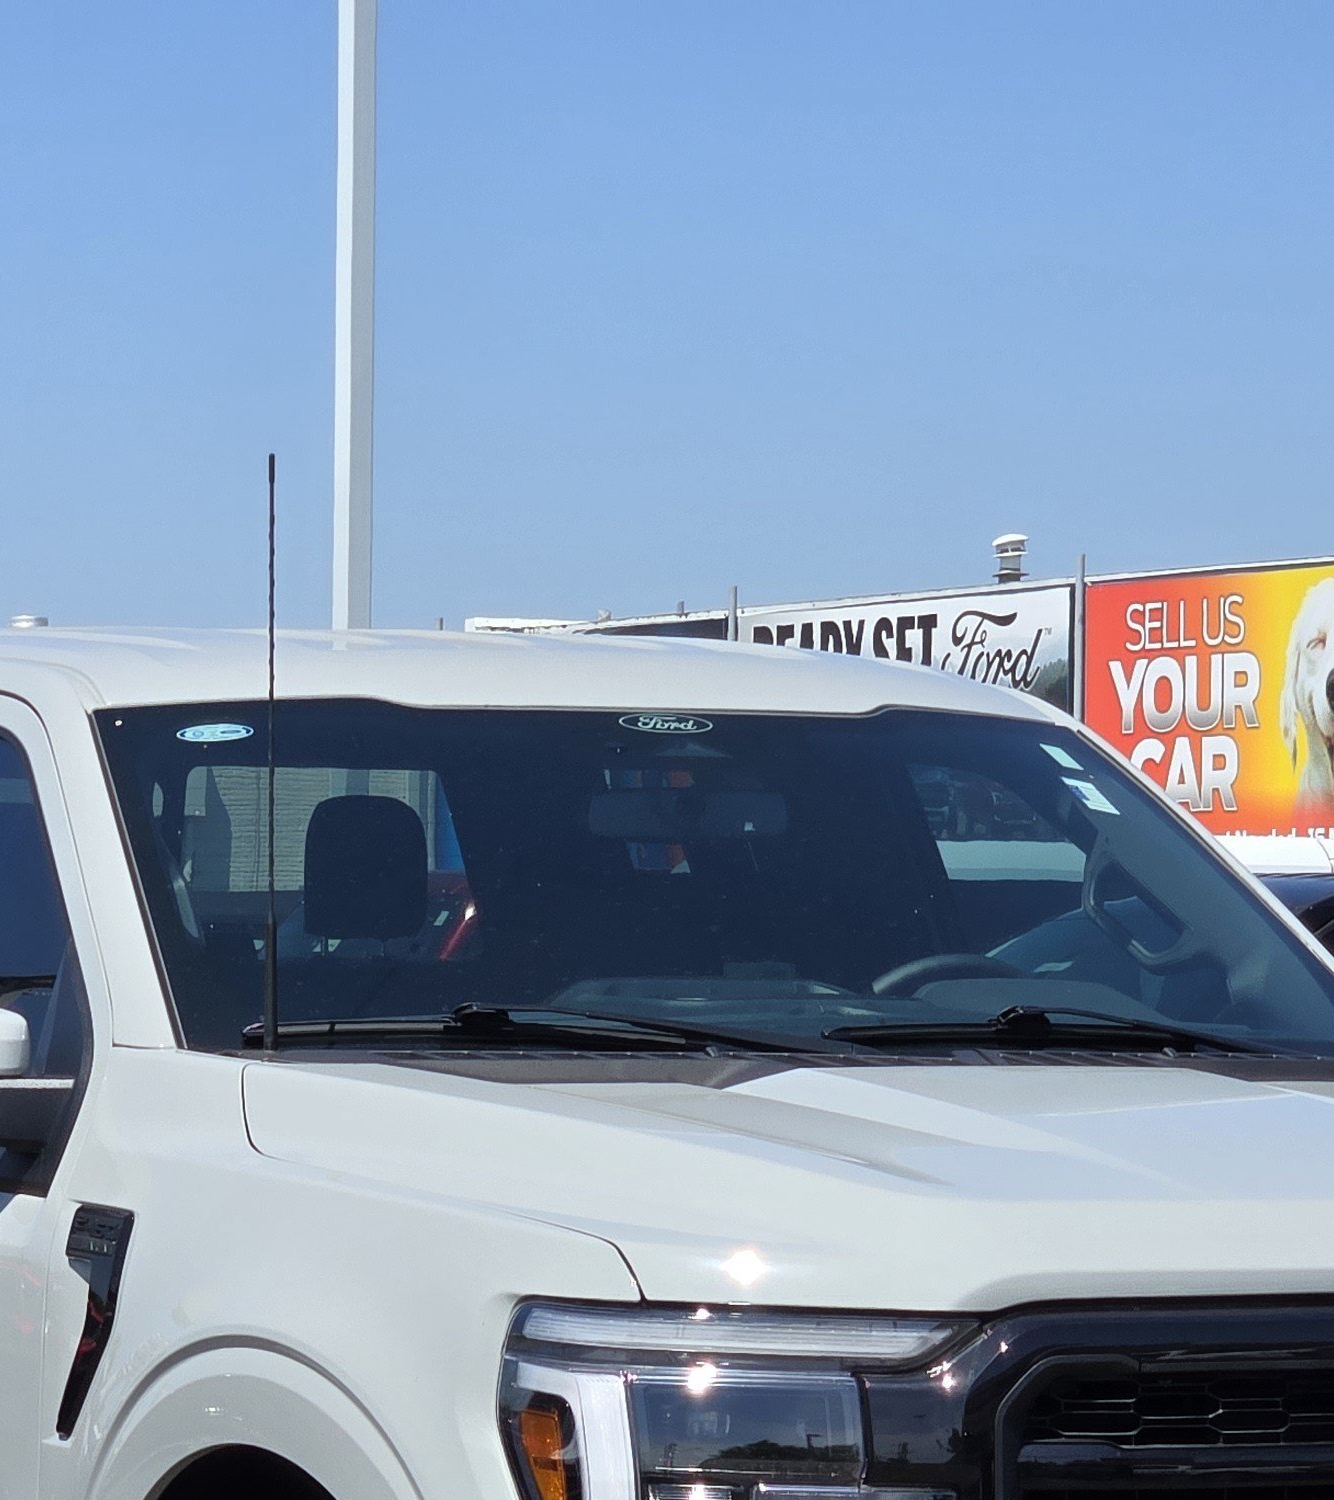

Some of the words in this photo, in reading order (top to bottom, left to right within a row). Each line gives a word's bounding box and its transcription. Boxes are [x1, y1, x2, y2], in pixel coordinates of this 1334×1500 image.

[1125, 600, 1197, 651] SELL
[1202, 595, 1245, 645] US
[1108, 652, 1261, 734] YOUR
[638, 715, 697, 730] Ford
